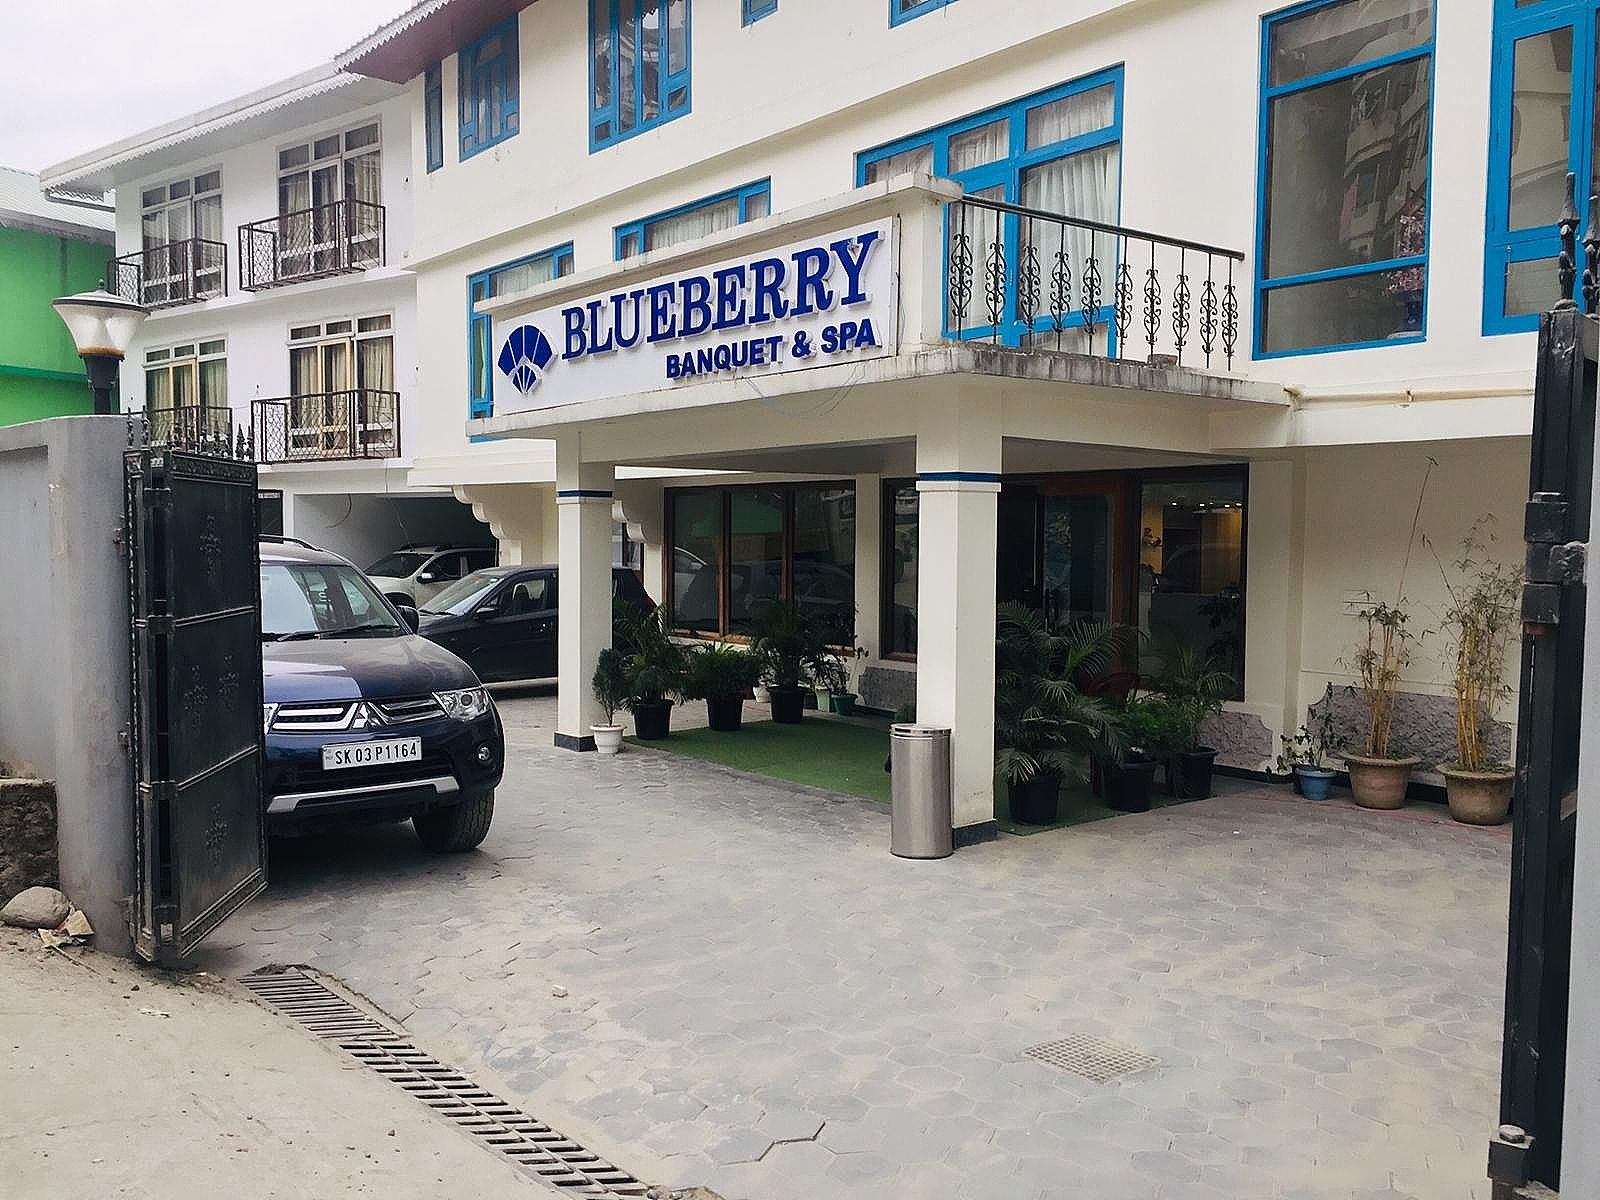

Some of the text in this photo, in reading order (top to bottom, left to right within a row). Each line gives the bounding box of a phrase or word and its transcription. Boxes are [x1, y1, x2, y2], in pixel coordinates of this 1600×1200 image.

[561, 230, 880, 360] BLUEBERRY
[666, 318, 876, 379] BANQUET & SPA
